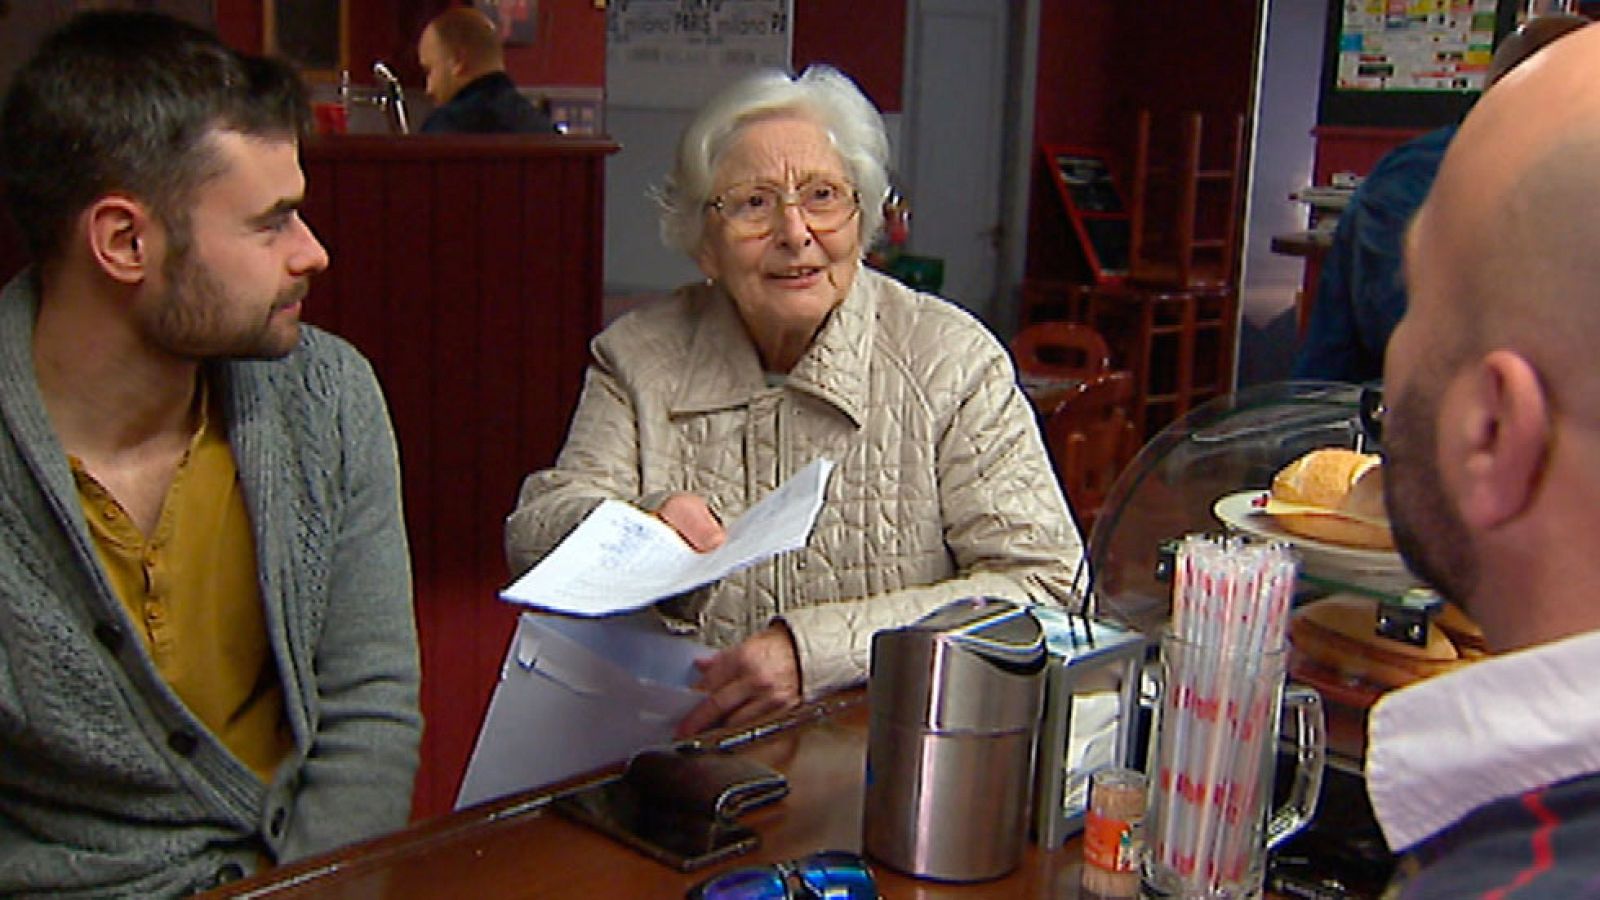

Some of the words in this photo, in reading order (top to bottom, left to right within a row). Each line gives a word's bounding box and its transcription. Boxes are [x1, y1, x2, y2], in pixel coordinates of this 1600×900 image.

[624, 13, 672, 34] milano
[675, 12, 712, 34] PARIS
[717, 14, 767, 35] milano
